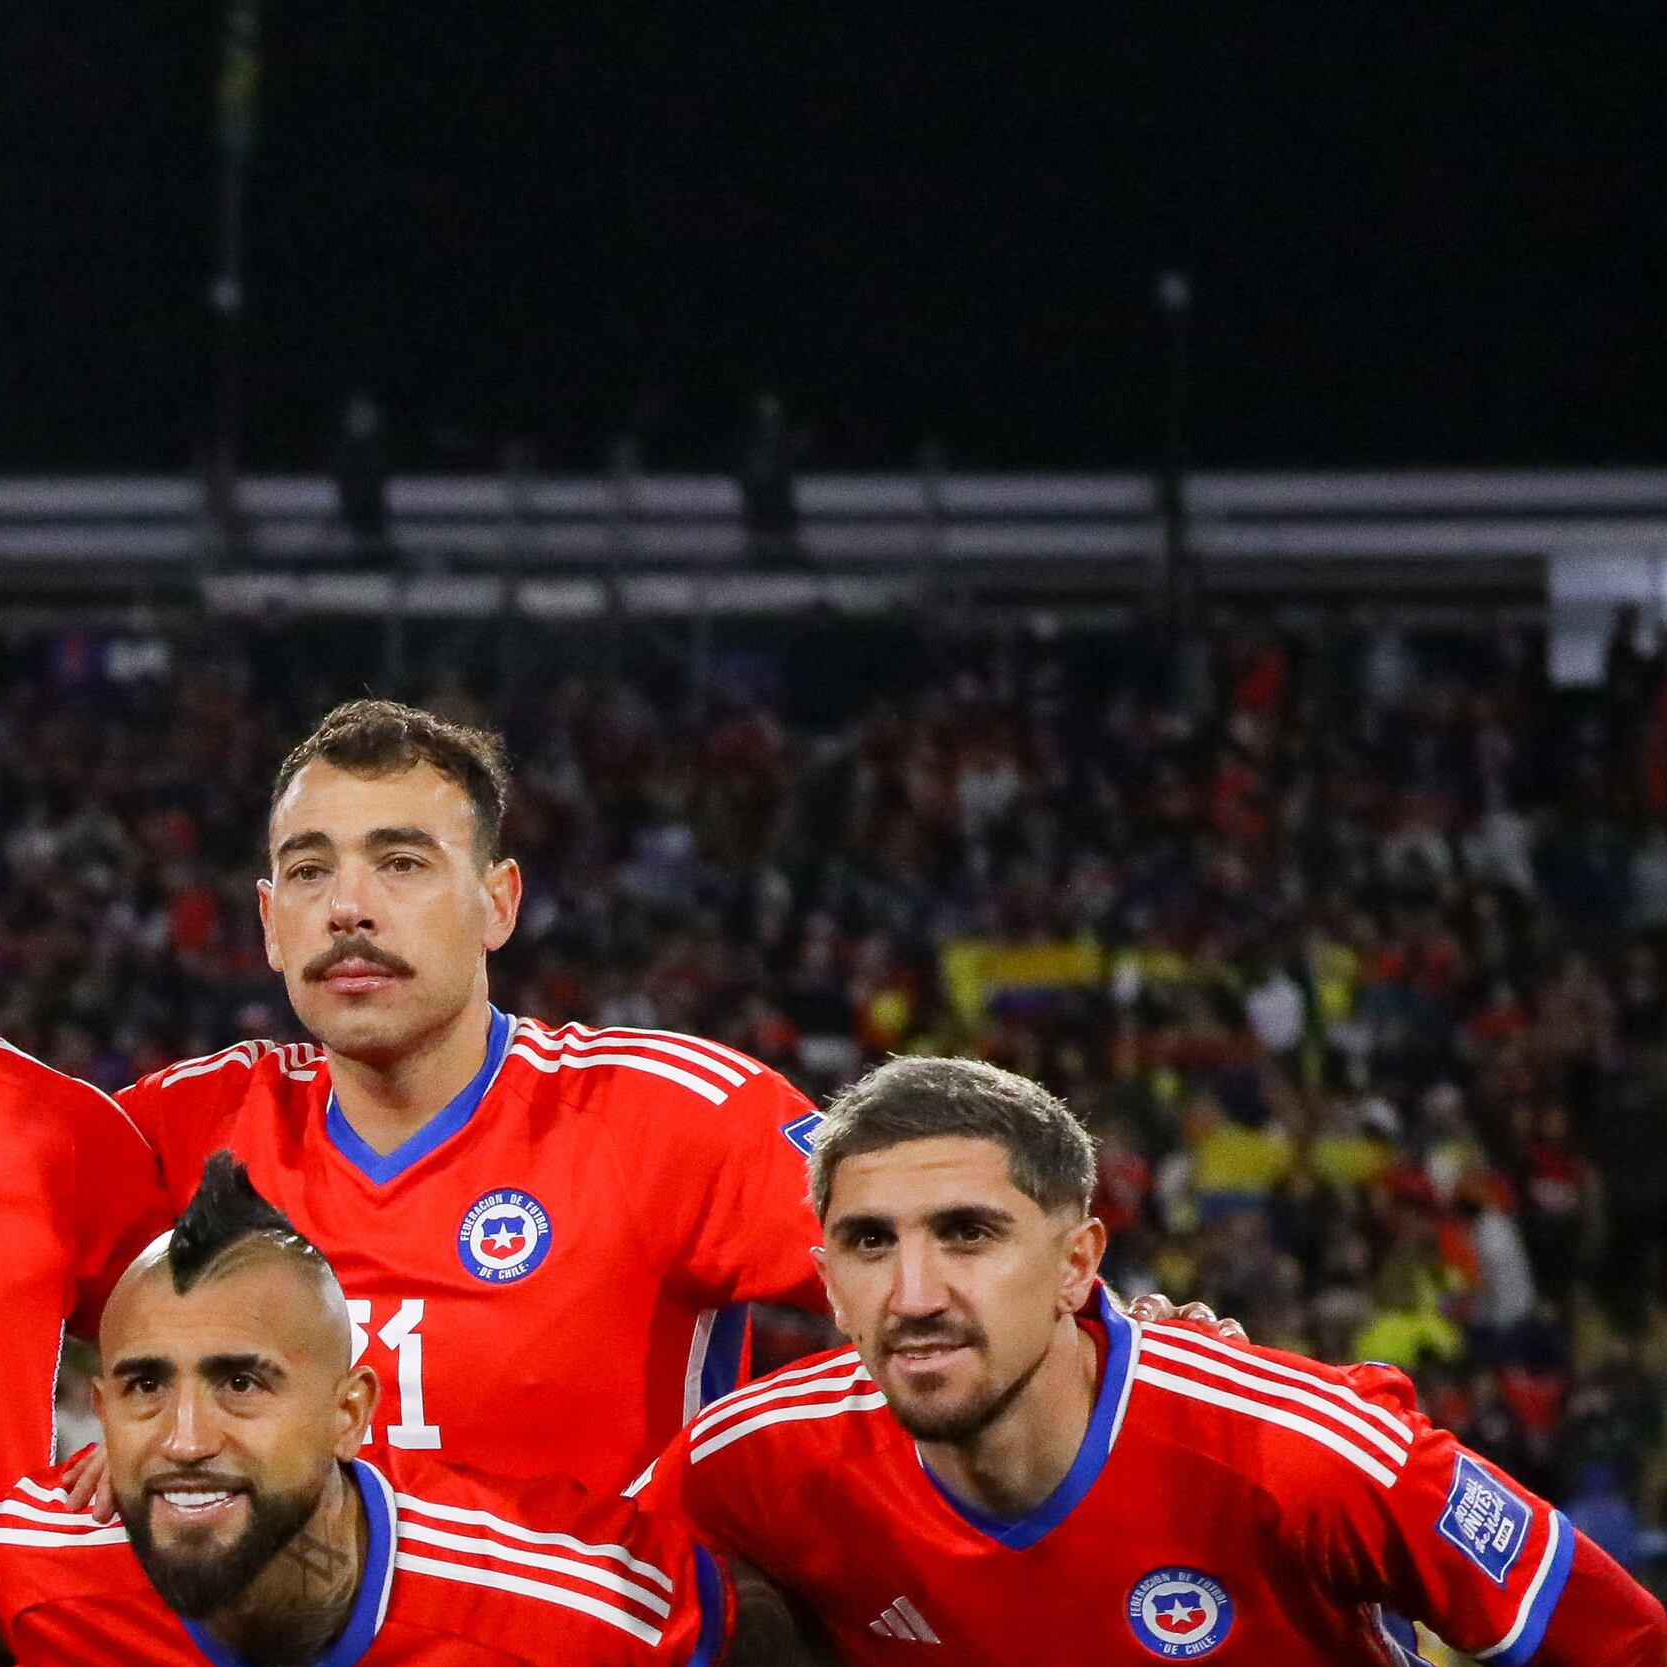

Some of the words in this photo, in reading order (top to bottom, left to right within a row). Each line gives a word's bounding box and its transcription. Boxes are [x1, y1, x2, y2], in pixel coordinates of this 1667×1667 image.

[459, 1193, 504, 1241] FEDERACION
[510, 1193, 524, 1206] DE
[525, 1201, 549, 1236] FUTBOL
[478, 1266, 494, 1279] DE
[498, 1262, 527, 1280] CHILE
[1462, 1485, 1492, 1540] UNITES
[1497, 1525, 1511, 1547] FIFA
[1178, 1572, 1193, 1581] DE
[1163, 1643, 1179, 1655] DE
[1185, 1635, 1216, 1655] CHILE
